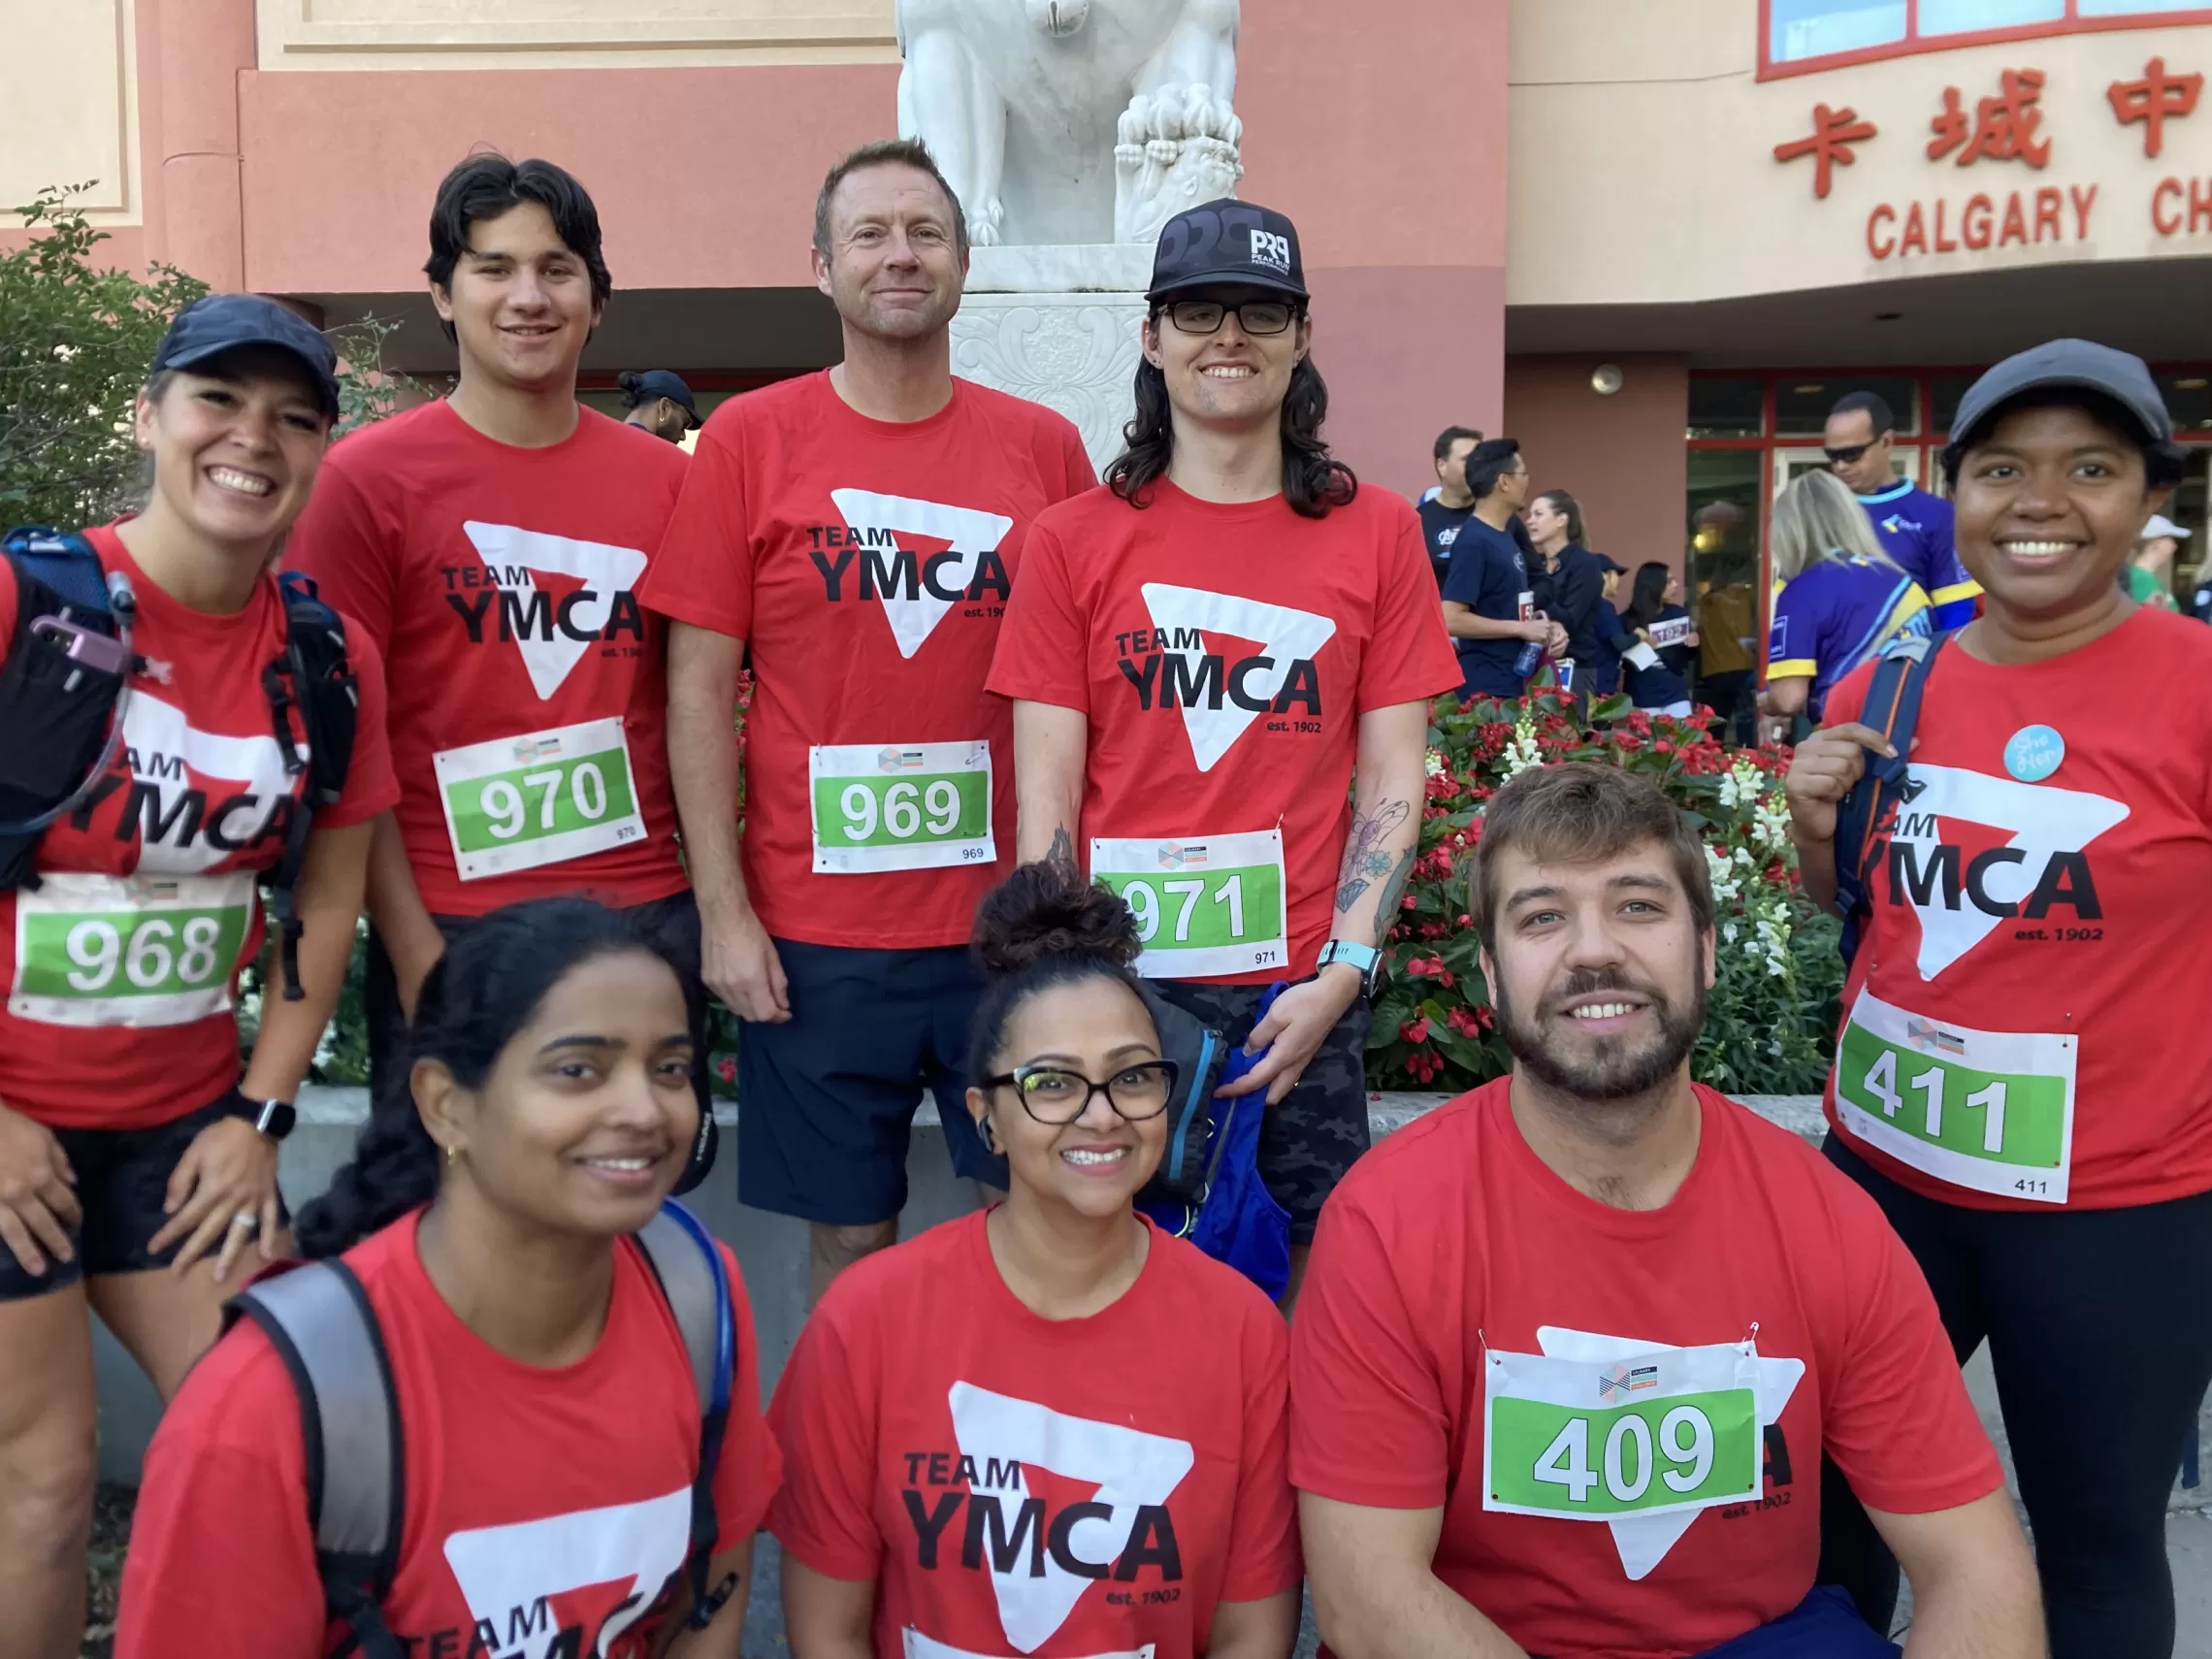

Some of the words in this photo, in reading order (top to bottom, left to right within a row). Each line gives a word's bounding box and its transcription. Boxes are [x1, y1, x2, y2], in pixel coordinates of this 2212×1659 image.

[1867, 183, 2099, 260] CALGARY
[1252, 254, 1274, 263] PEAK
[1275, 259, 1290, 271] RUN
[807, 527, 894, 548] TEAM
[442, 565, 531, 590] TEAM
[809, 550, 1011, 602] YMCA
[443, 590, 644, 643] YMCA
[964, 608, 984, 617] est.
[1115, 628, 1201, 657] TEAM
[1116, 653, 1322, 716] YMCA
[1267, 720, 1289, 732] est.
[1294, 721, 1321, 733] 1902
[116, 746, 182, 781] AM
[479, 762, 608, 840] 970
[840, 779, 961, 841] 969
[616, 825, 636, 840] 970
[1873, 813, 1937, 838] AM
[962, 848, 984, 860] 969
[1121, 874, 1245, 943] 971
[2015, 928, 2049, 940] est.
[2055, 927, 2103, 941] 1902
[66, 917, 220, 991] 968
[1254, 951, 1276, 964] 971
[1863, 1049, 2008, 1154] 411
[2014, 1178, 2048, 1194] 411
[1533, 1405, 1715, 1502] 409
[903, 1452, 1021, 1491] TEAM
[1754, 1492, 1791, 1512] 1902
[902, 1489, 1183, 1583] YMCA
